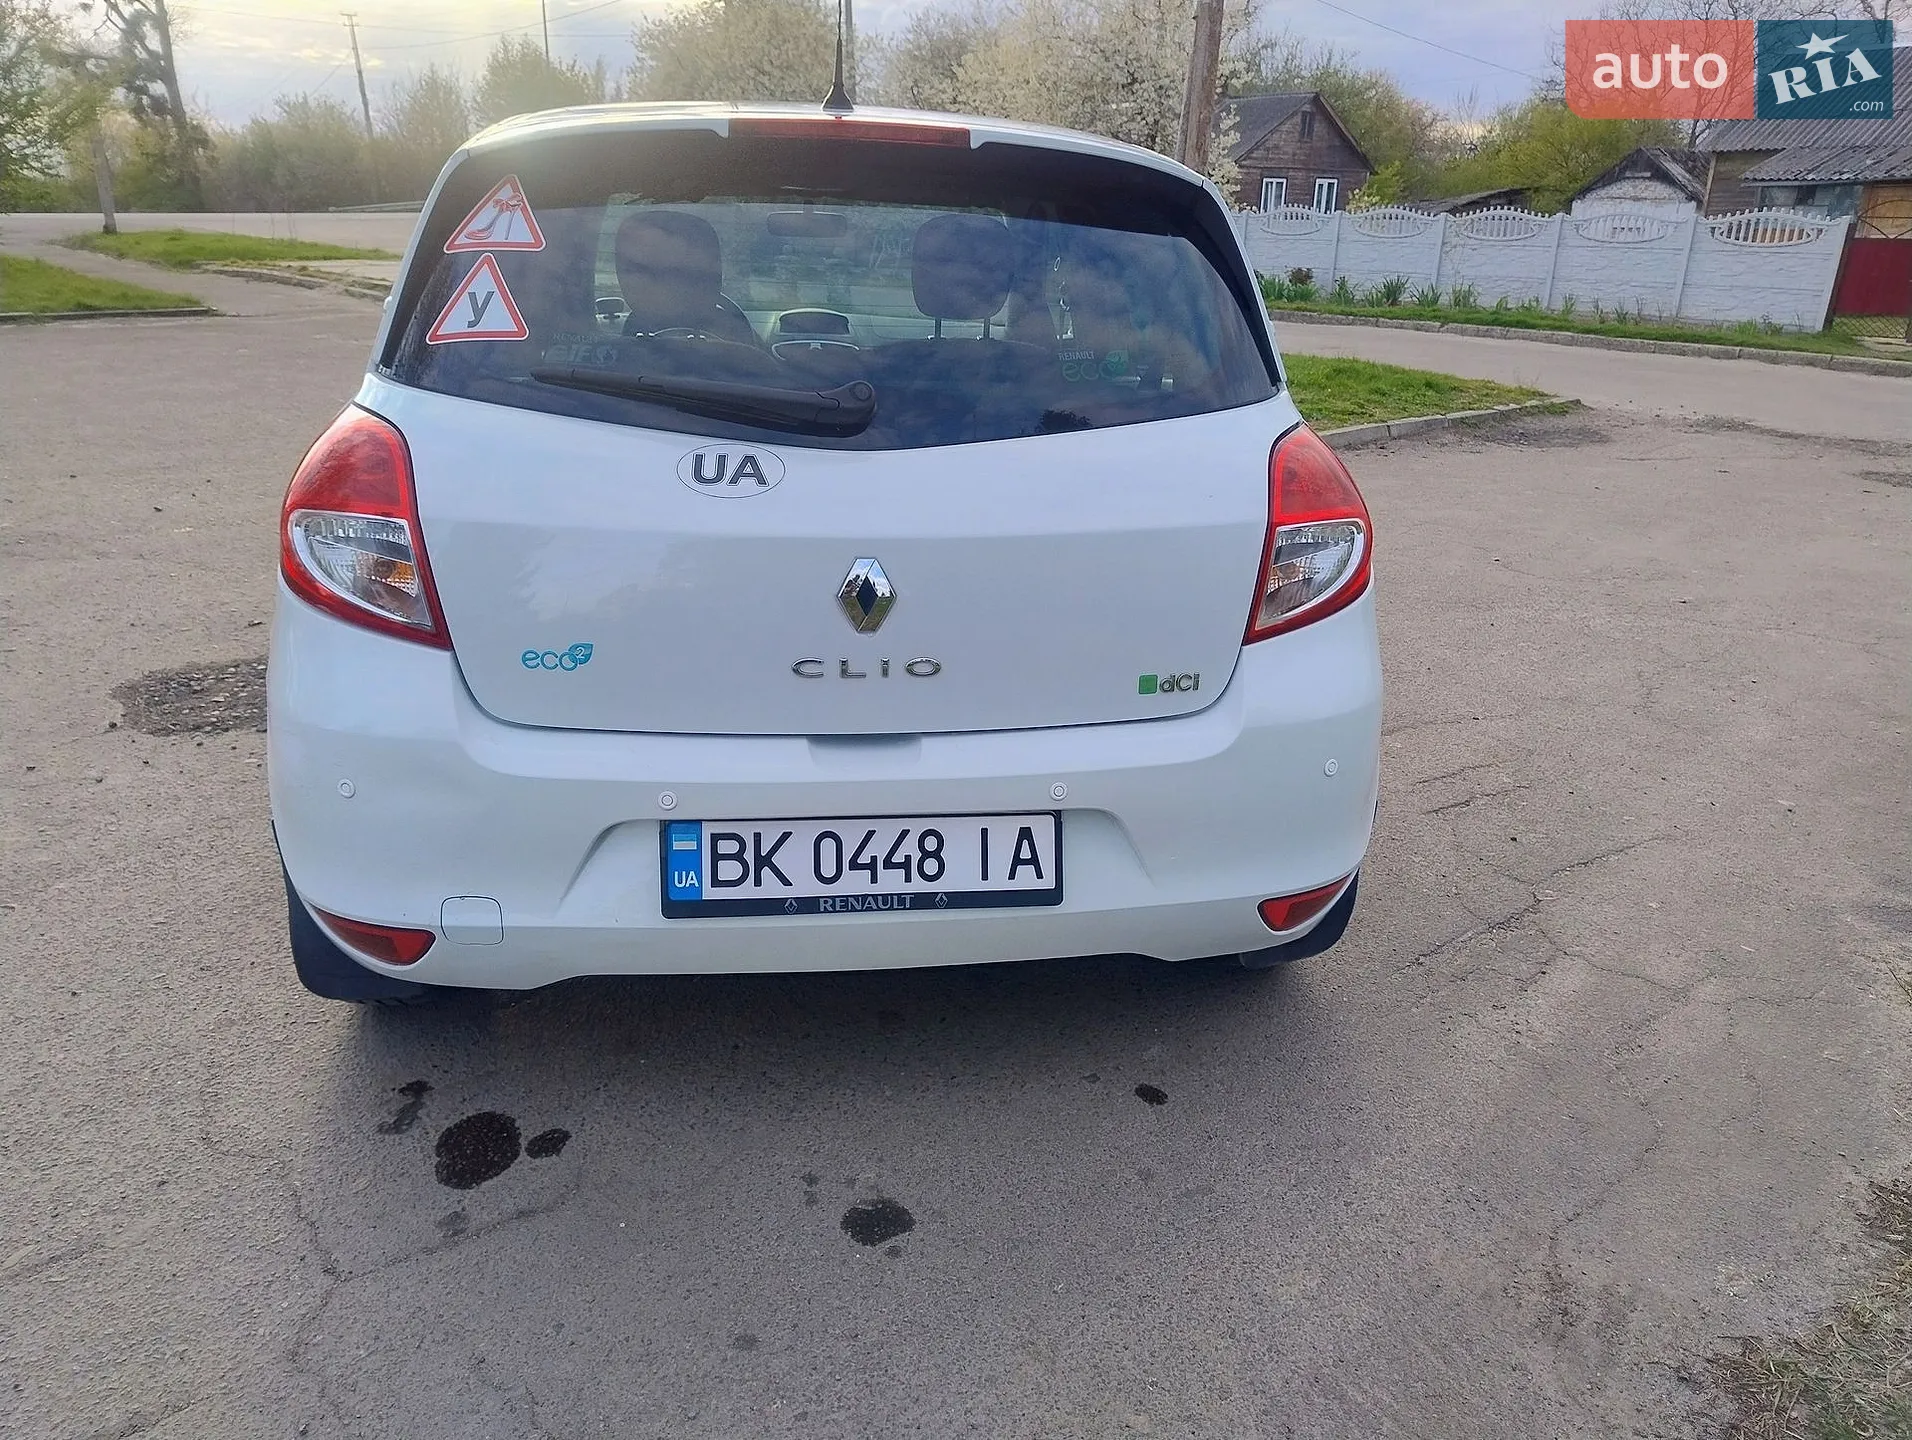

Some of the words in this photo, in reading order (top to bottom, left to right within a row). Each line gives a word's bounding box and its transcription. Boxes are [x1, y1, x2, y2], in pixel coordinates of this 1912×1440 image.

[1059, 350, 1095, 361] RENAULT
[691, 452, 769, 487] UA
[710, 831, 793, 888] BK
[813, 828, 946, 885] 0448
[980, 826, 1044, 881] IA
[674, 870, 699, 888] UA
[818, 894, 915, 912] RENAULT
